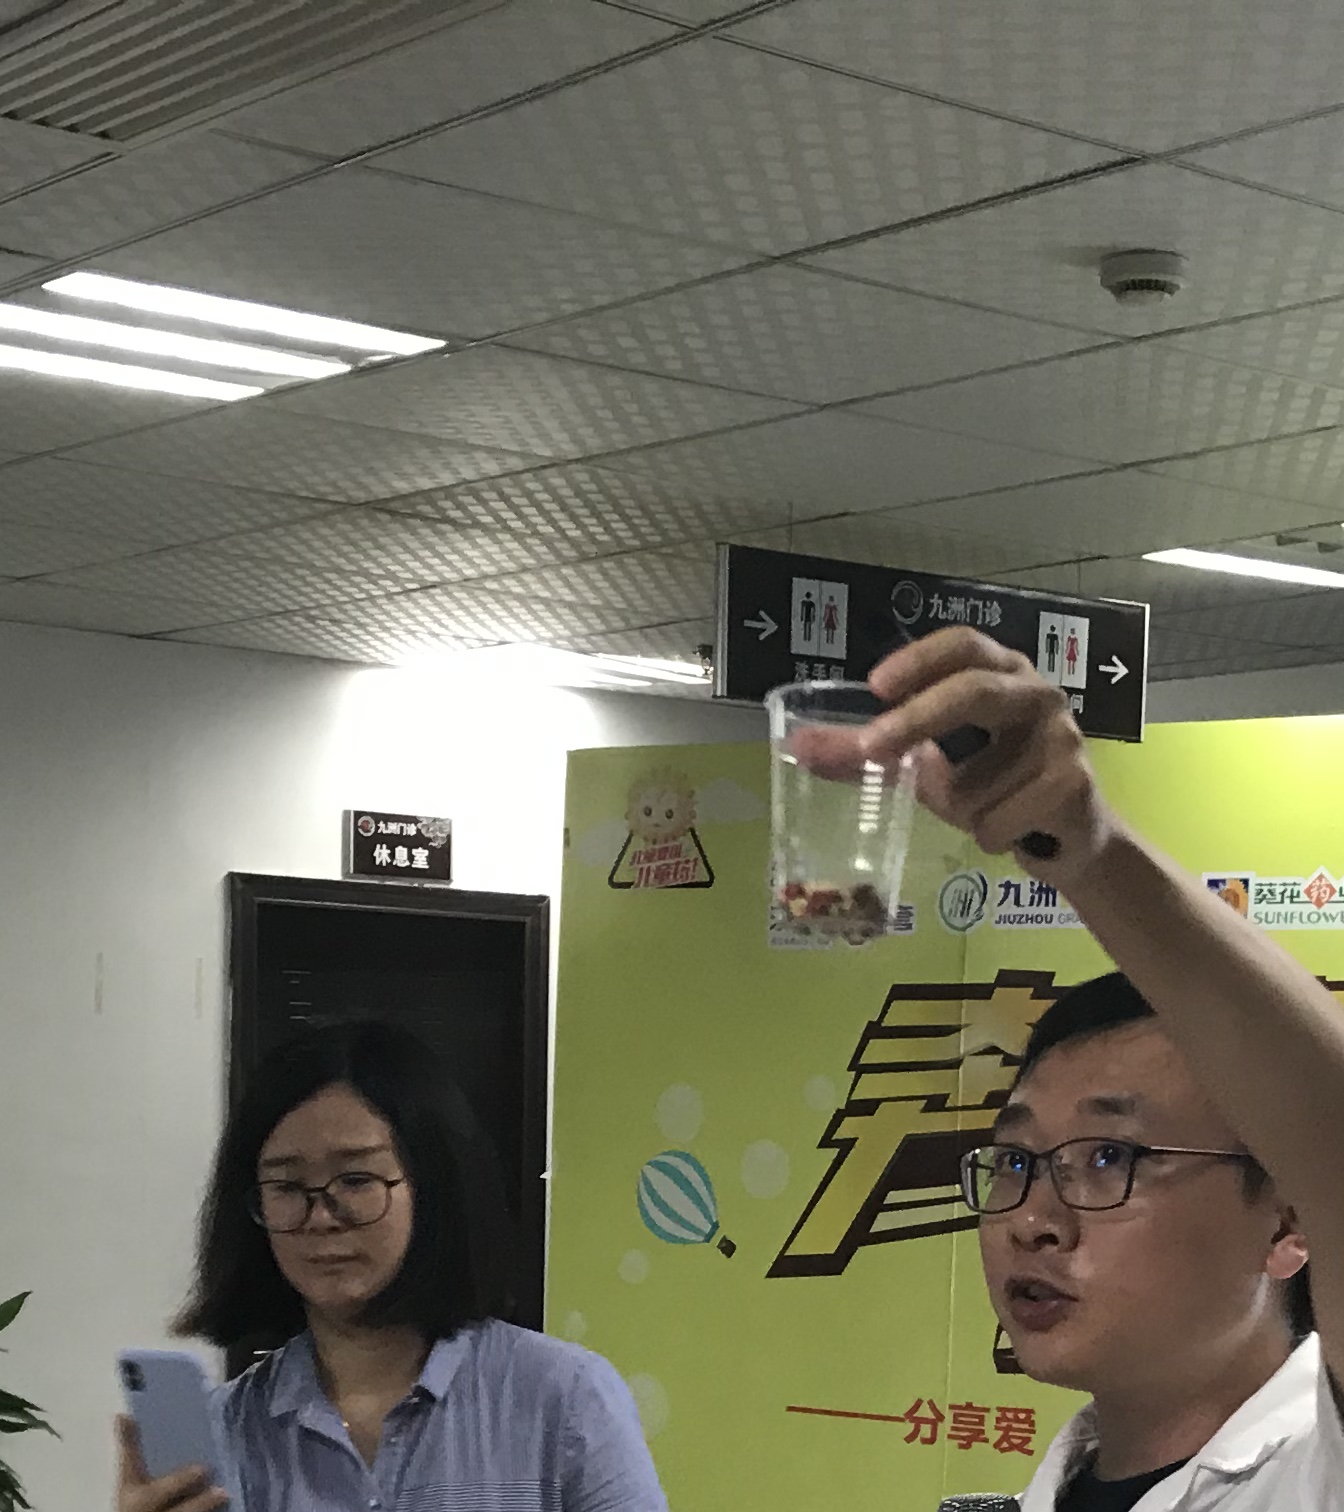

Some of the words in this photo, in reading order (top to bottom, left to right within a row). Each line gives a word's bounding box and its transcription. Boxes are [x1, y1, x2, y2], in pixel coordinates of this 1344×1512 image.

[373, 843, 430, 869] 休息室
[997, 880, 1057, 908] 九洲
[994, 913, 1054, 925] JIUZHOU
